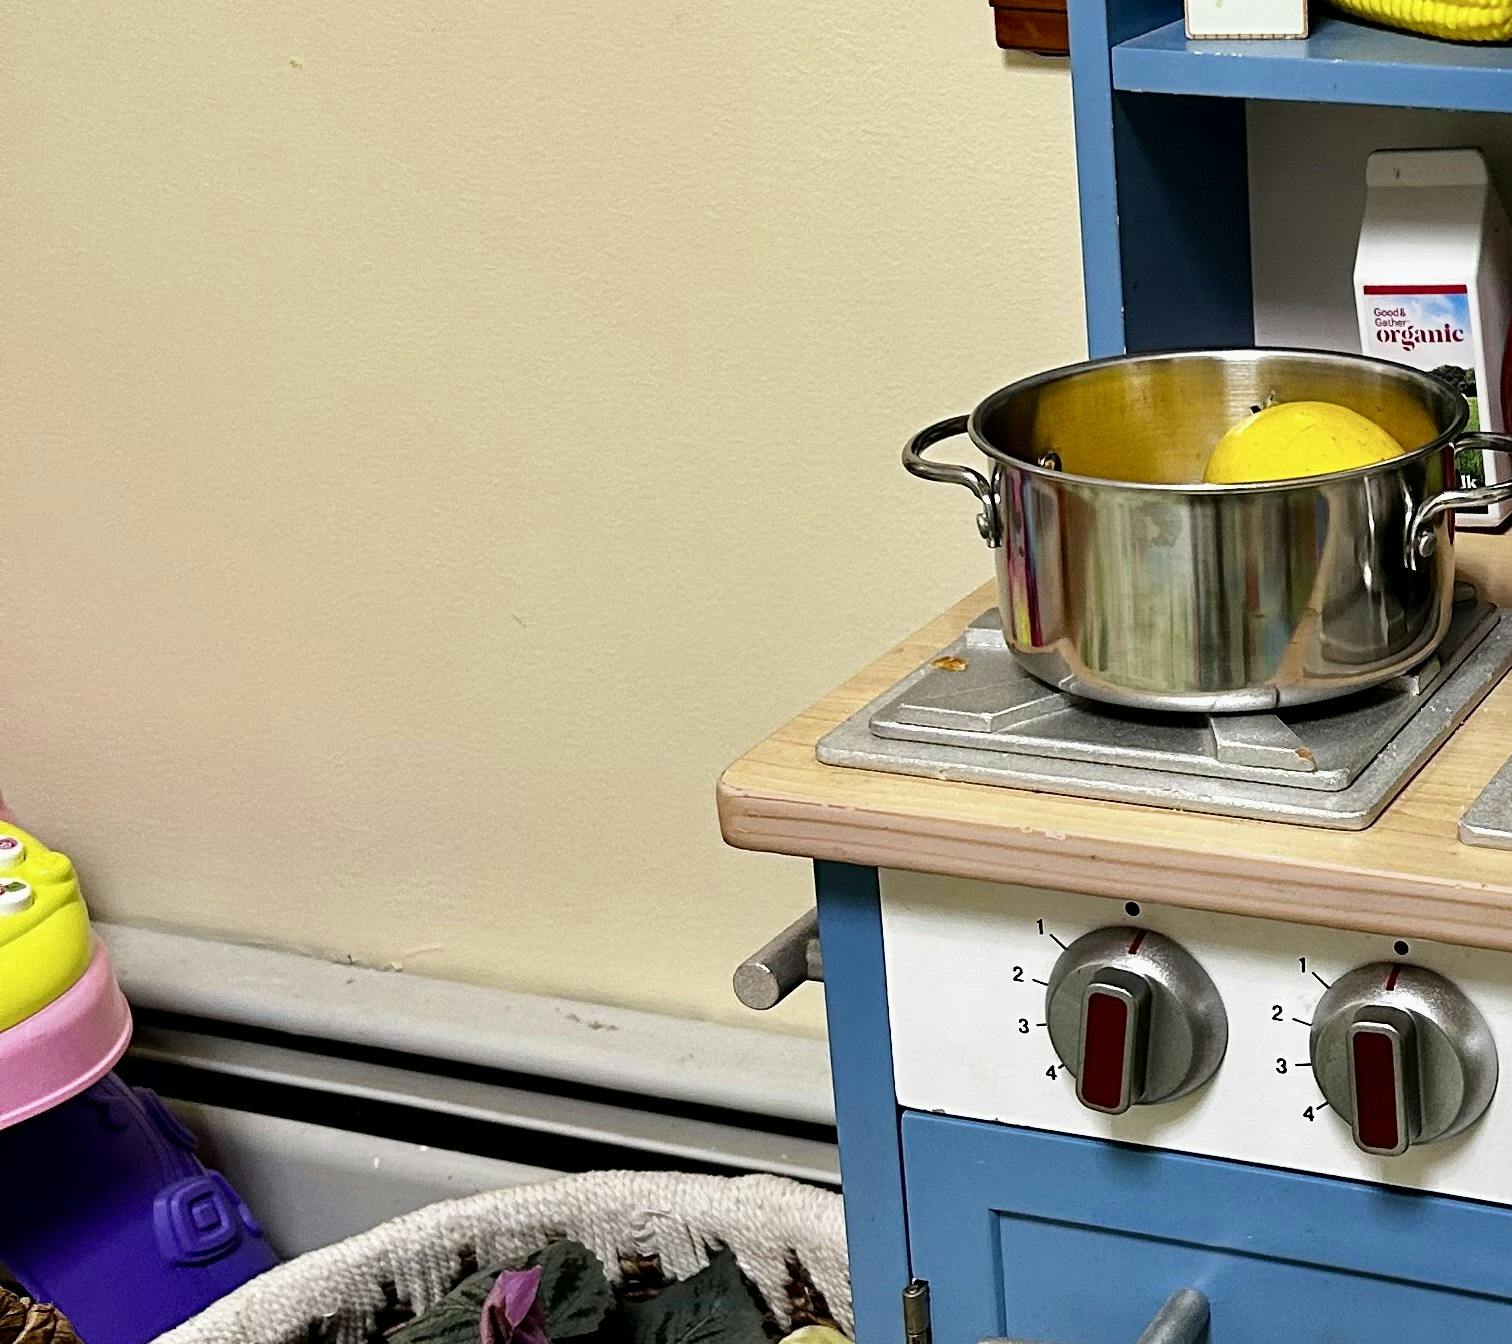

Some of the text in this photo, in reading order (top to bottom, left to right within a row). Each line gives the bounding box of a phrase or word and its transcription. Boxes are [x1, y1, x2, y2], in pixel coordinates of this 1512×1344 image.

[1374, 308, 1399, 316] Good
[1375, 318, 1406, 327] Gather
[1377, 324, 1464, 351] organic
[1036, 919, 1044, 935] 1
[1299, 957, 1306, 973] 1
[1012, 966, 1024, 983] 2
[1271, 1004, 1284, 1022] 2
[1018, 1018, 1030, 1034] 3
[1045, 1065, 1058, 1080] 4
[1275, 1058, 1288, 1074] 3
[1302, 1106, 1315, 1122] 4
